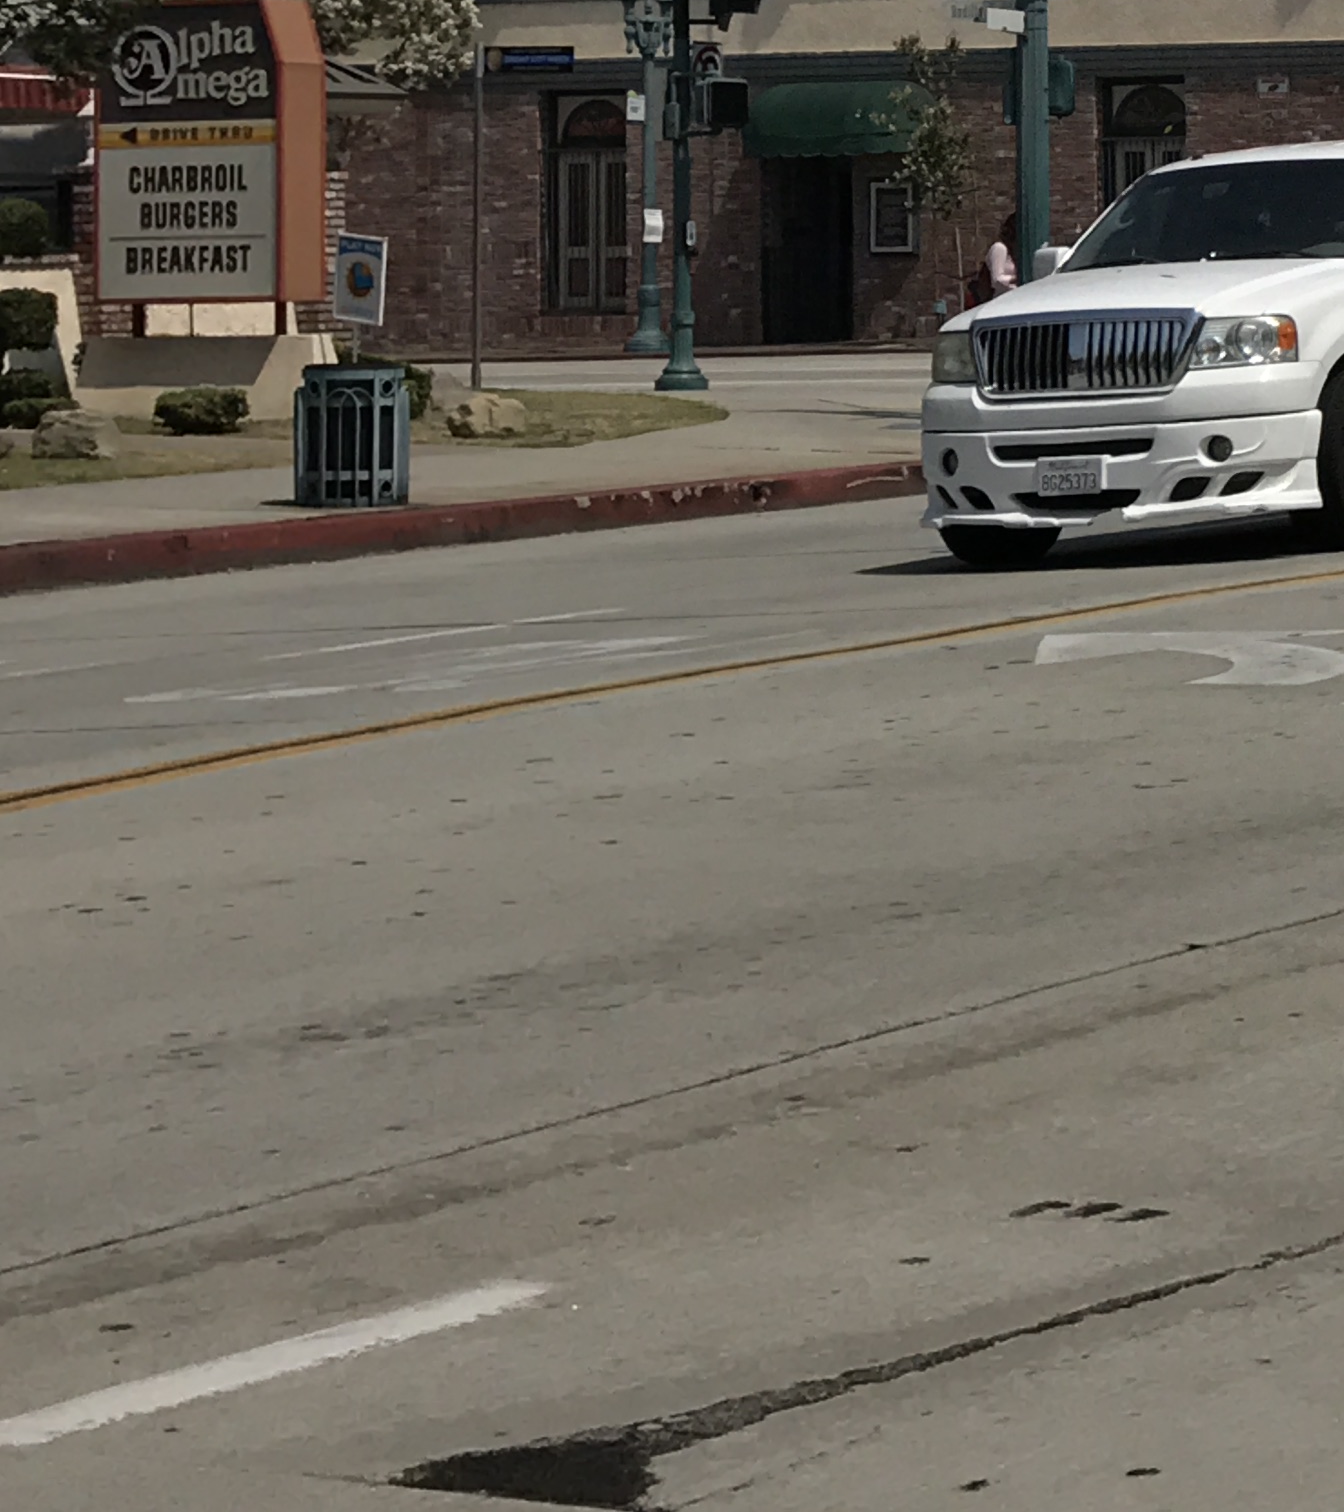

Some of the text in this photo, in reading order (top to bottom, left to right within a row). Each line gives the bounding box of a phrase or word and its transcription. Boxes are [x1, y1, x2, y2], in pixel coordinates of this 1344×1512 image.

[122, 20, 256, 80] Alpha
[150, 126, 253, 141] DRIVE THRU
[128, 164, 247, 194] CHARBROIL
[140, 200, 238, 229] BURGERS
[125, 245, 251, 275] BREAKFAST
[1041, 472, 1097, 491] 8G25373
